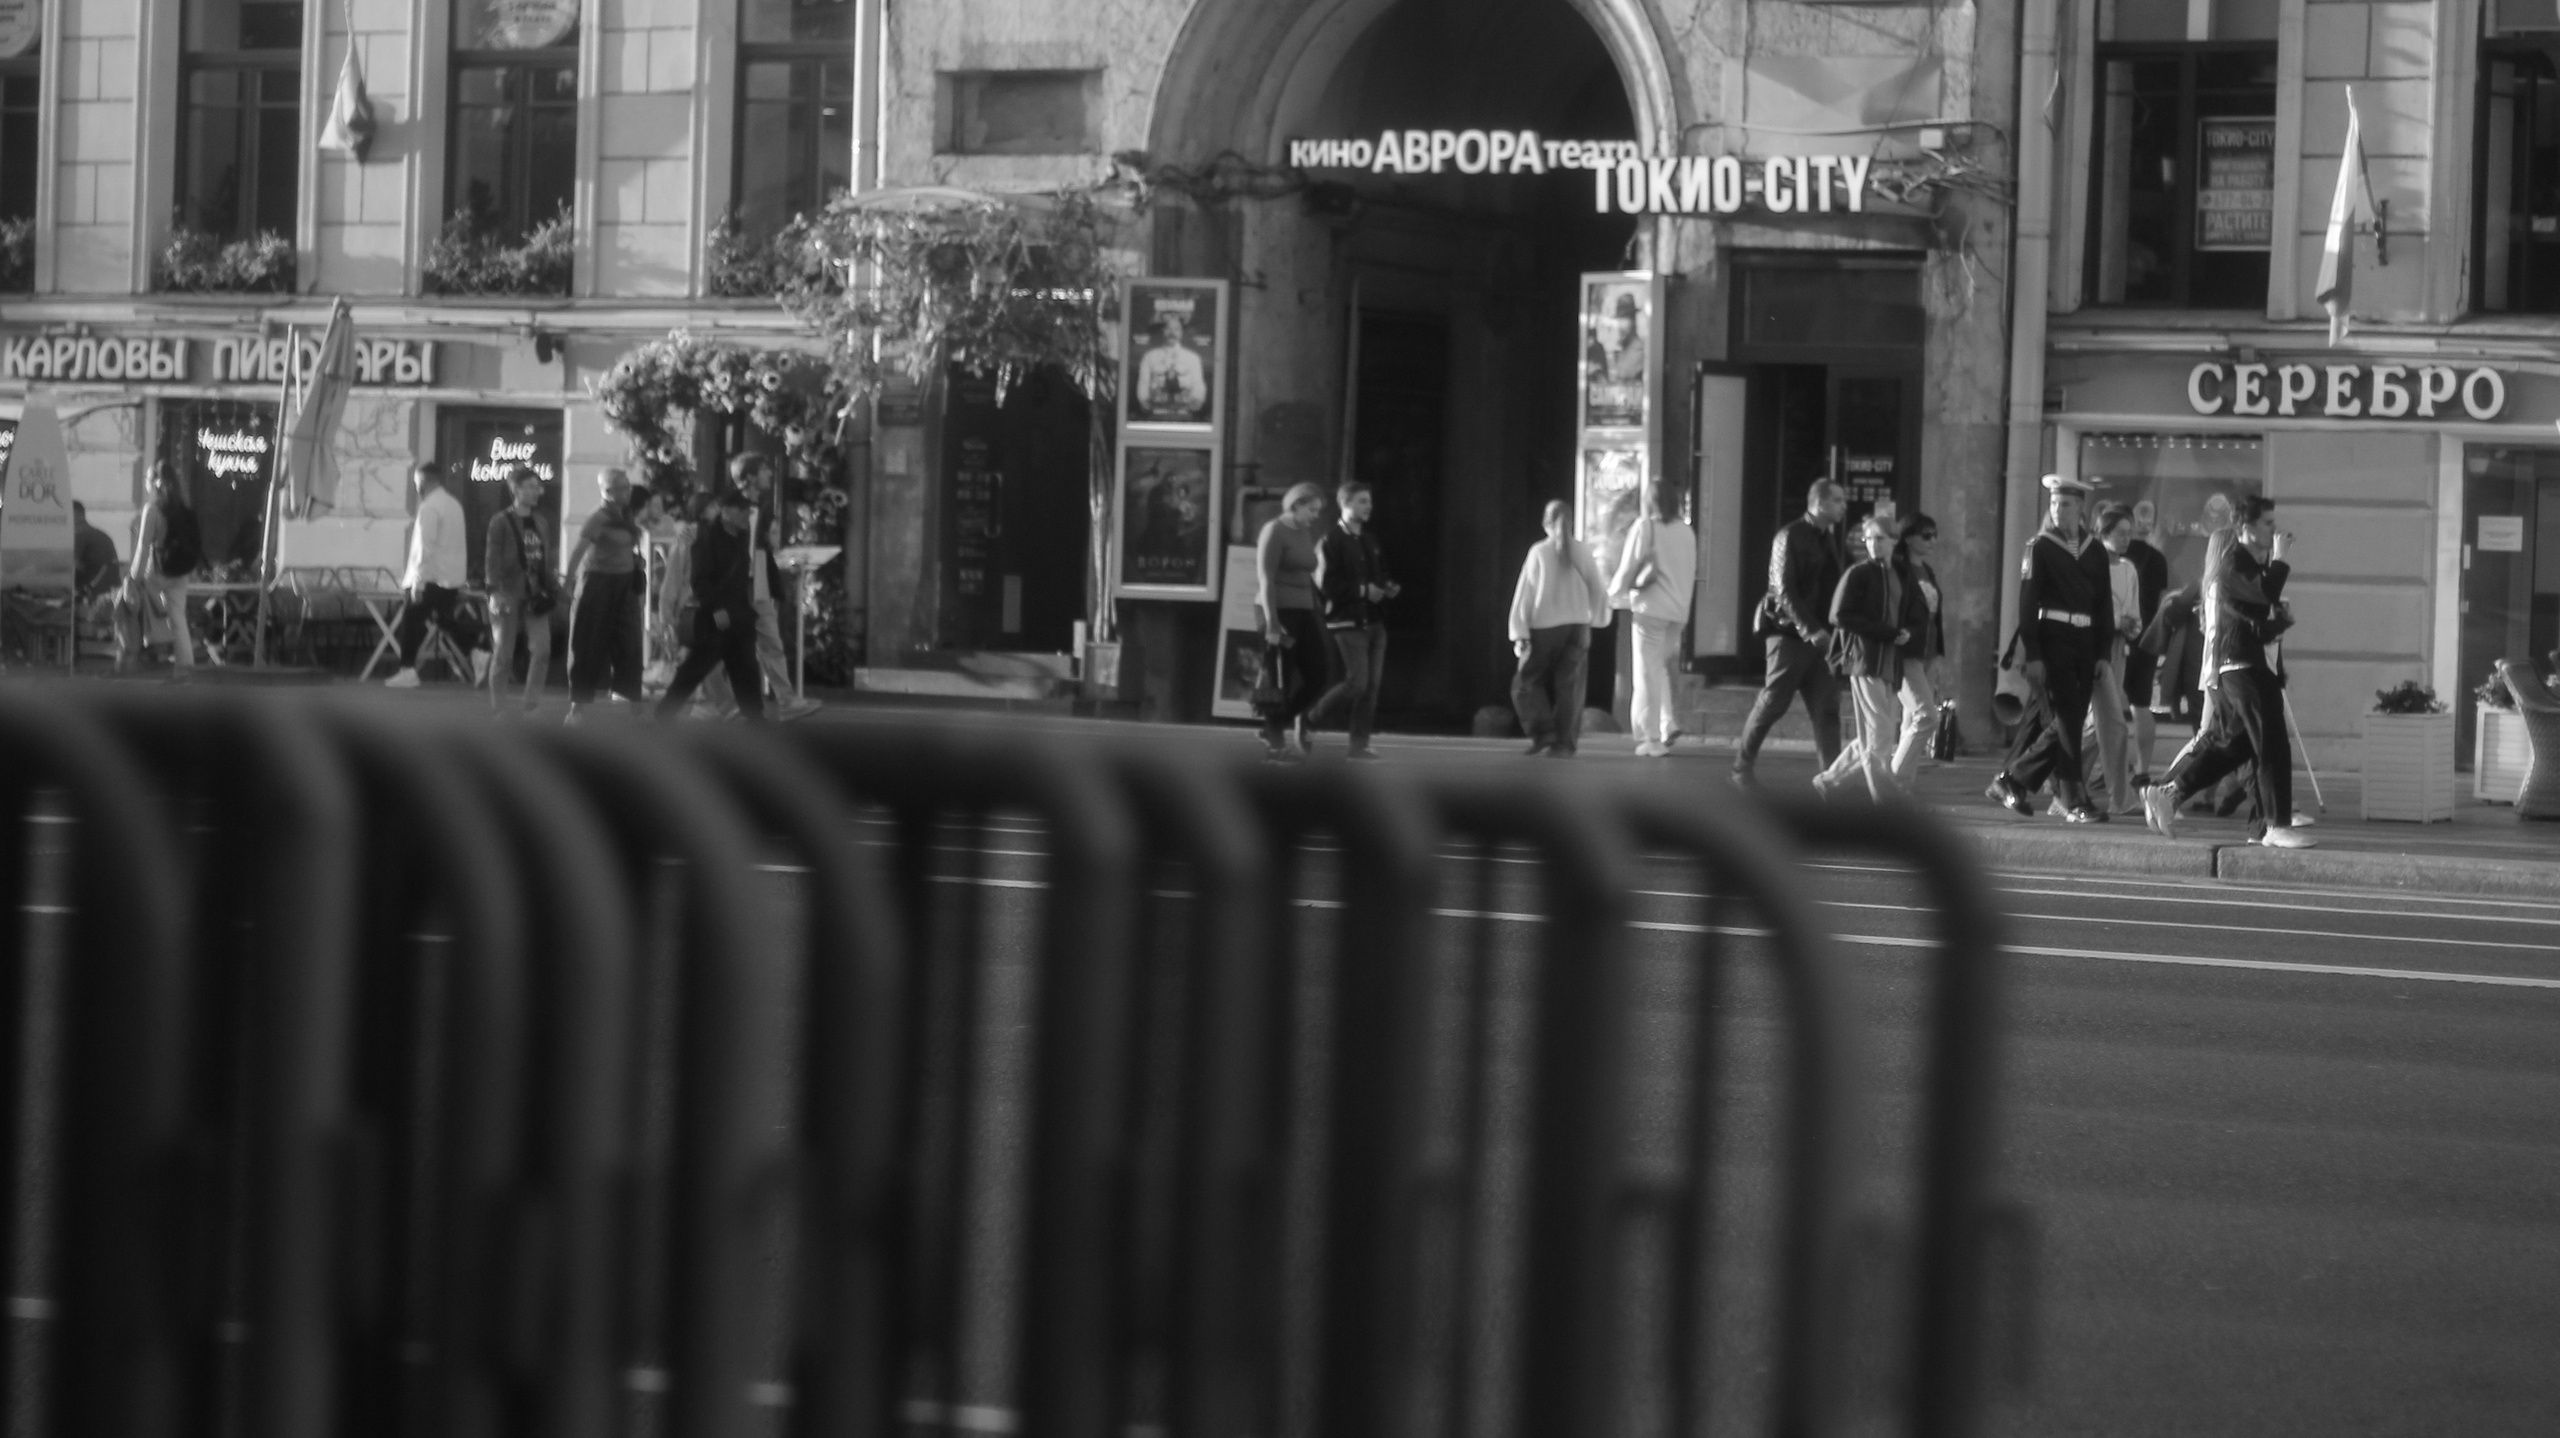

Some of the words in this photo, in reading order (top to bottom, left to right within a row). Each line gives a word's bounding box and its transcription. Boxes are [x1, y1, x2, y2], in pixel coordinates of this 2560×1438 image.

[1290, 138, 1371, 168] кино
[1371, 129, 1545, 174] АВРОРА
[3, 337, 190, 379] КАРЛОВЫ
[212, 338, 433, 383] ПИВОАРЫ
[2187, 362, 2505, 420] СЕРЕБРО
[490, 436, 537, 461] Вино
